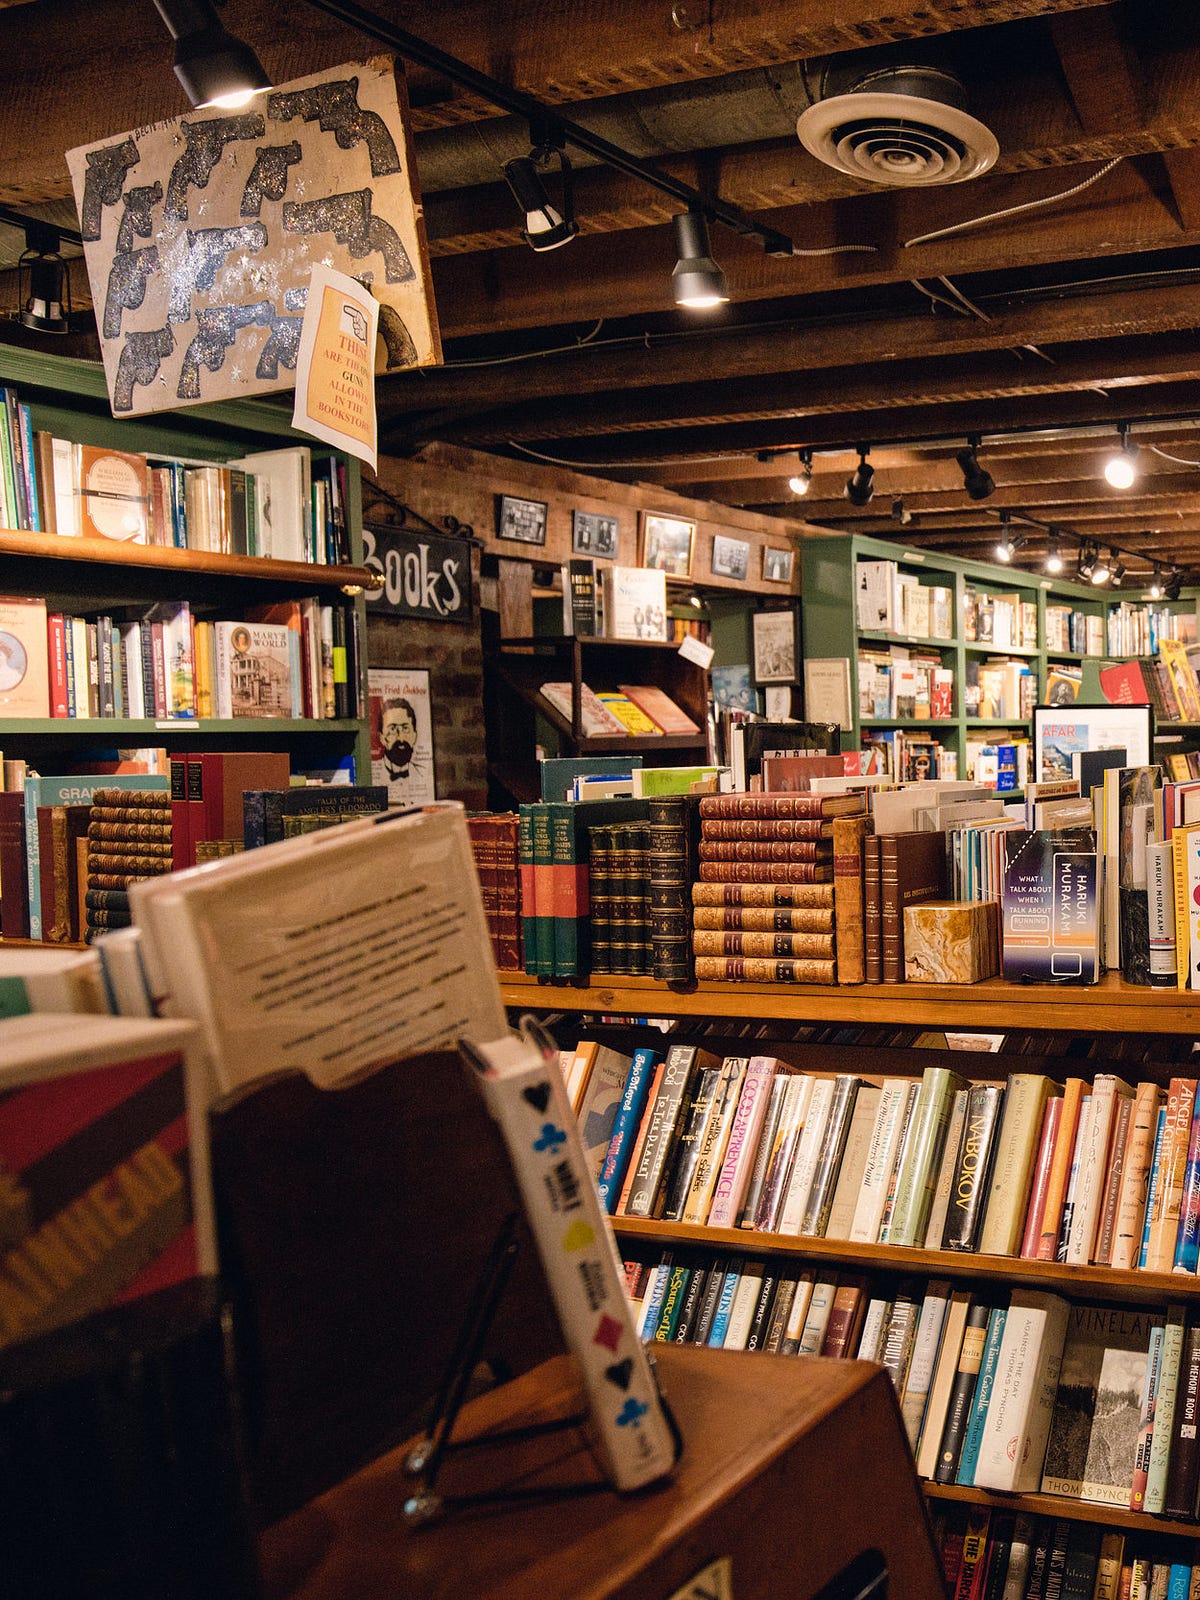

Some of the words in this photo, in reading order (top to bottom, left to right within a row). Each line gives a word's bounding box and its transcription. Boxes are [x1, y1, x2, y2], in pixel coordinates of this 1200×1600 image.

[324, 349, 343, 365] ARE
[338, 334, 367, 363] THESE
[342, 370, 364, 388] GUNS
[334, 394, 345, 406] IN
[347, 399, 364, 414] THE
[363, 529, 462, 616] Books
[253, 631, 287, 639] MARY'S
[253, 639, 287, 648] WORLD
[1042, 724, 1075, 737] AFAR
[1061, 863, 1072, 936] MURAKAMI
[1077, 875, 1087, 924] HARUKI
[1176, 872, 1184, 916] MURAKAMI
[1014, 917, 1046, 925] RUNNING
[1156, 890, 1164, 935] MURAKAMI
[633, 1054, 646, 1076] Jojo
[623, 1074, 641, 1111] Moyes
[656, 1095, 669, 1112] TO
[738, 1079, 758, 1119] GOOD
[881, 1088, 893, 1106] The
[1168, 1096, 1177, 1112] OF
[649, 1112, 665, 1135] THE
[1176, 1085, 1194, 1136] ANGEL
[1160, 1116, 1177, 1162] LIGHT
[637, 1135, 658, 1179] PLANET
[716, 1121, 750, 1199] APPRENTICE
[955, 1115, 986, 1212] NABOKOV
[1002, 1134, 1017, 1185] MEMORIES
[863, 1164, 876, 1188] Pupil
[1108, 1177, 1118, 1211] HOWARD
[1103, 1214, 1112, 1259] NORMAN
[663, 1279, 683, 1315] Source
[662, 1315, 670, 1327] of
[700, 1293, 714, 1332] PICTURES
[991, 1316, 1005, 1345] Some
[1018, 1320, 1032, 1358] AGAINST
[883, 1328, 906, 1369] PROULX
[986, 1345, 1000, 1373] Tame
[1005, 1348, 1018, 1386] THOMAS
[1017, 1360, 1025, 1378] THE
[1188, 1363, 1200, 1396] MEMORY
[977, 1374, 993, 1412] Gazelle
[1012, 1379, 1021, 1398] DAY
[956, 1393, 966, 1420] MICHAEL
[995, 1388, 1009, 1431] PYNCHON
[1184, 1398, 1196, 1420] ROOM
[971, 1414, 984, 1444] Barbara
[1159, 1388, 1176, 1467] LESSONS
[967, 1445, 977, 1464] Pym
[1136, 1444, 1144, 1470] QUICK
[1142, 1433, 1152, 1472] MATTHEW
[1048, 1481, 1093, 1497] THOMAS
[1096, 1488, 1131, 1501] PYNCH
[965, 1537, 980, 1563] THE
